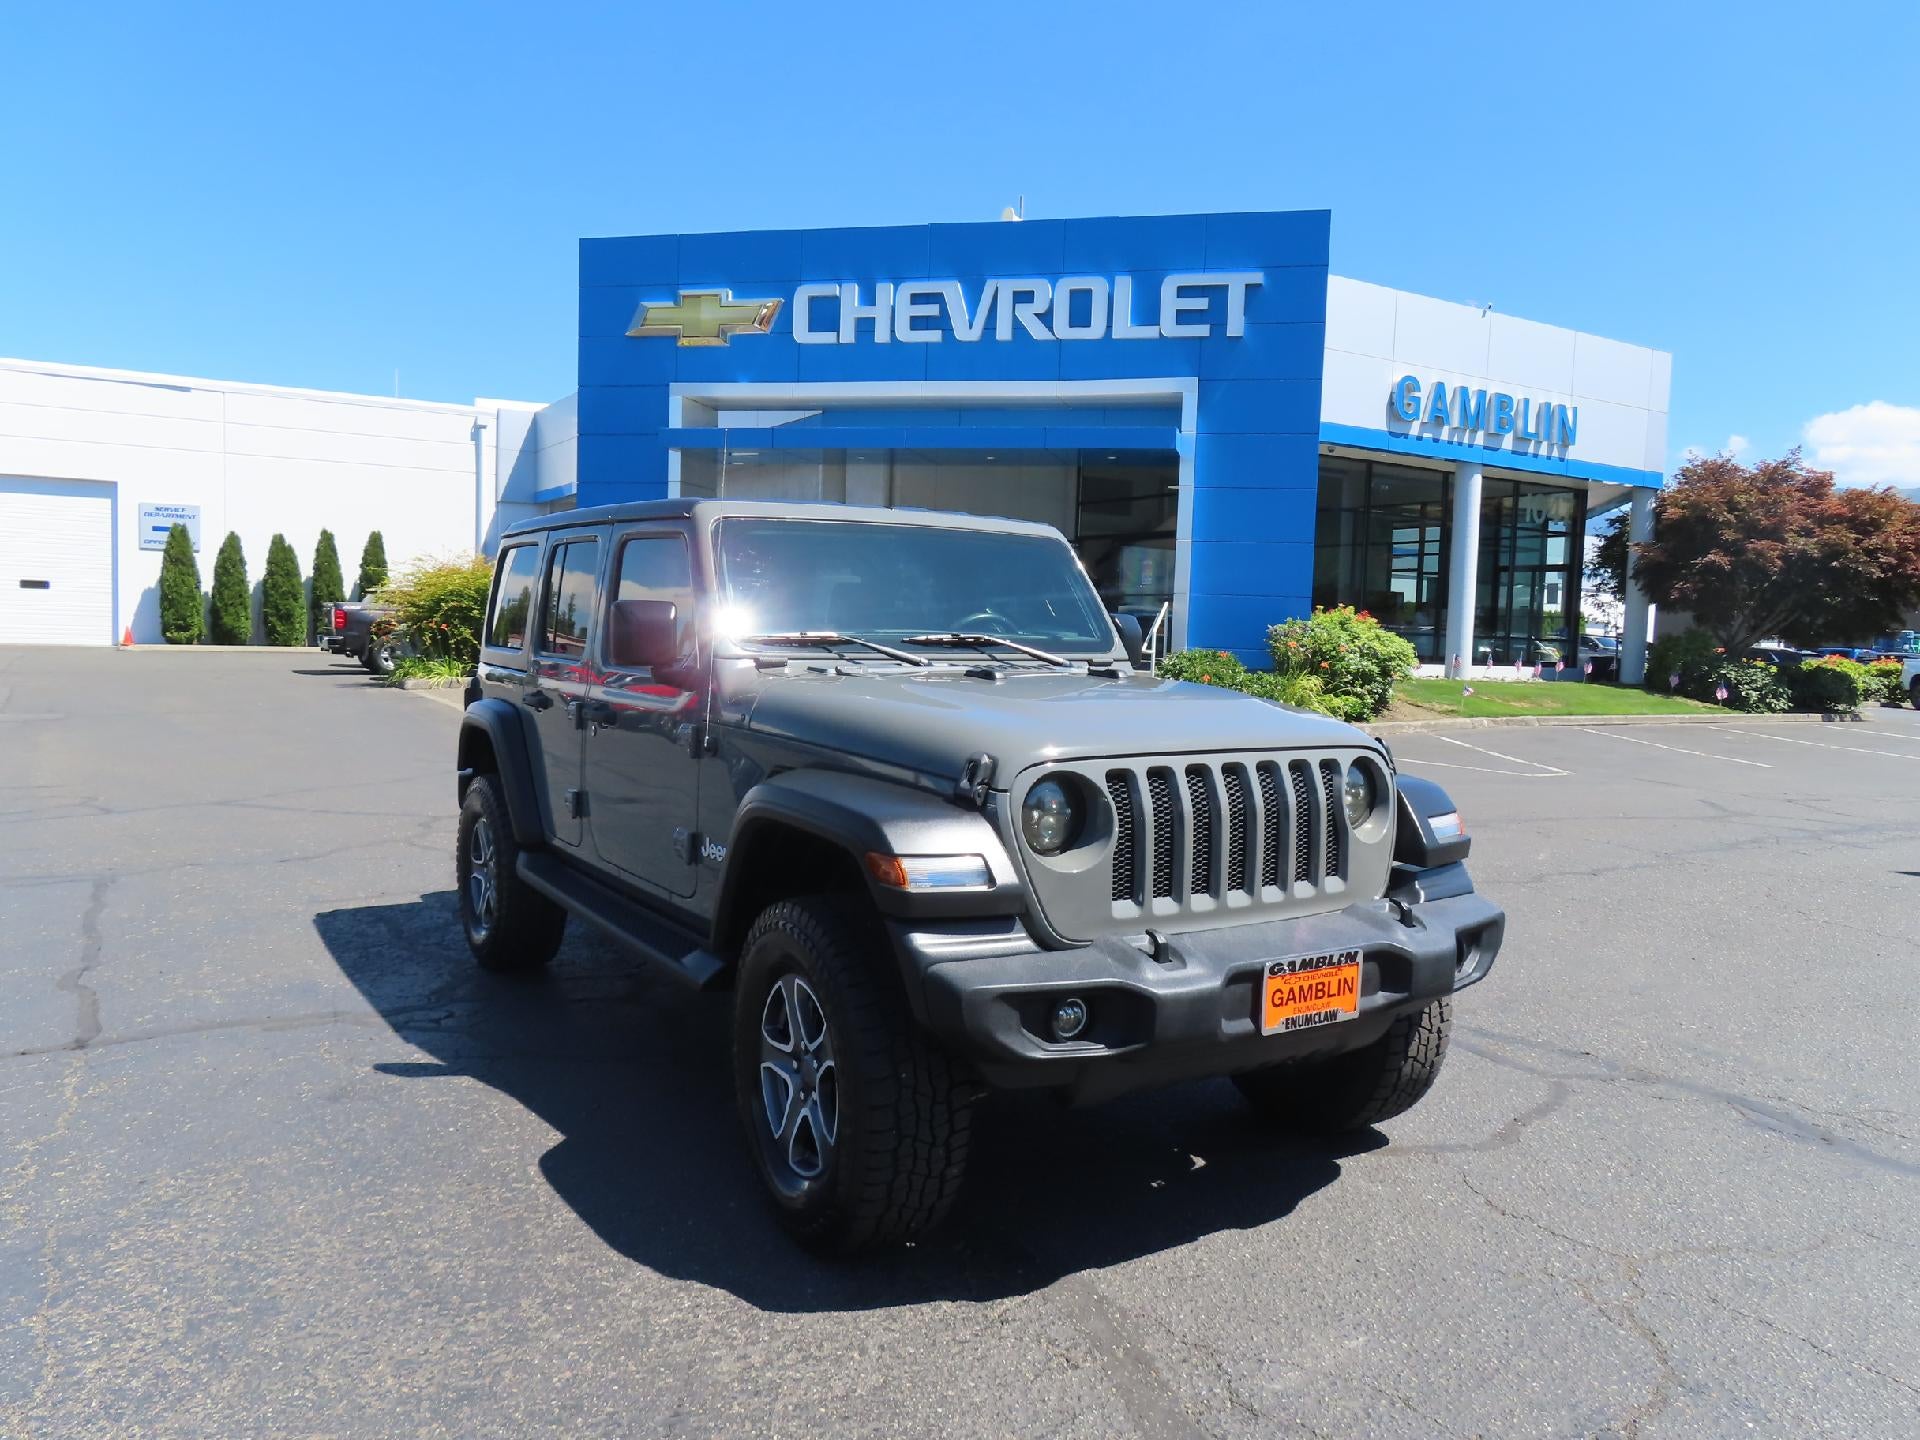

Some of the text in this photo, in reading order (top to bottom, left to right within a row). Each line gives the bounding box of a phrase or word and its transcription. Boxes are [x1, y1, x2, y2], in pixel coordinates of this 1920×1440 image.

[792, 272, 1264, 344] CHEVROLET
[1393, 375, 1578, 447] GAMBLIN
[143, 511, 197, 519] DEPARTMENT
[1268, 951, 1359, 976] GAMBLIN
[1271, 976, 1355, 1008] GAMBLIN
[1284, 1009, 1339, 1030] ENUMCLAW
